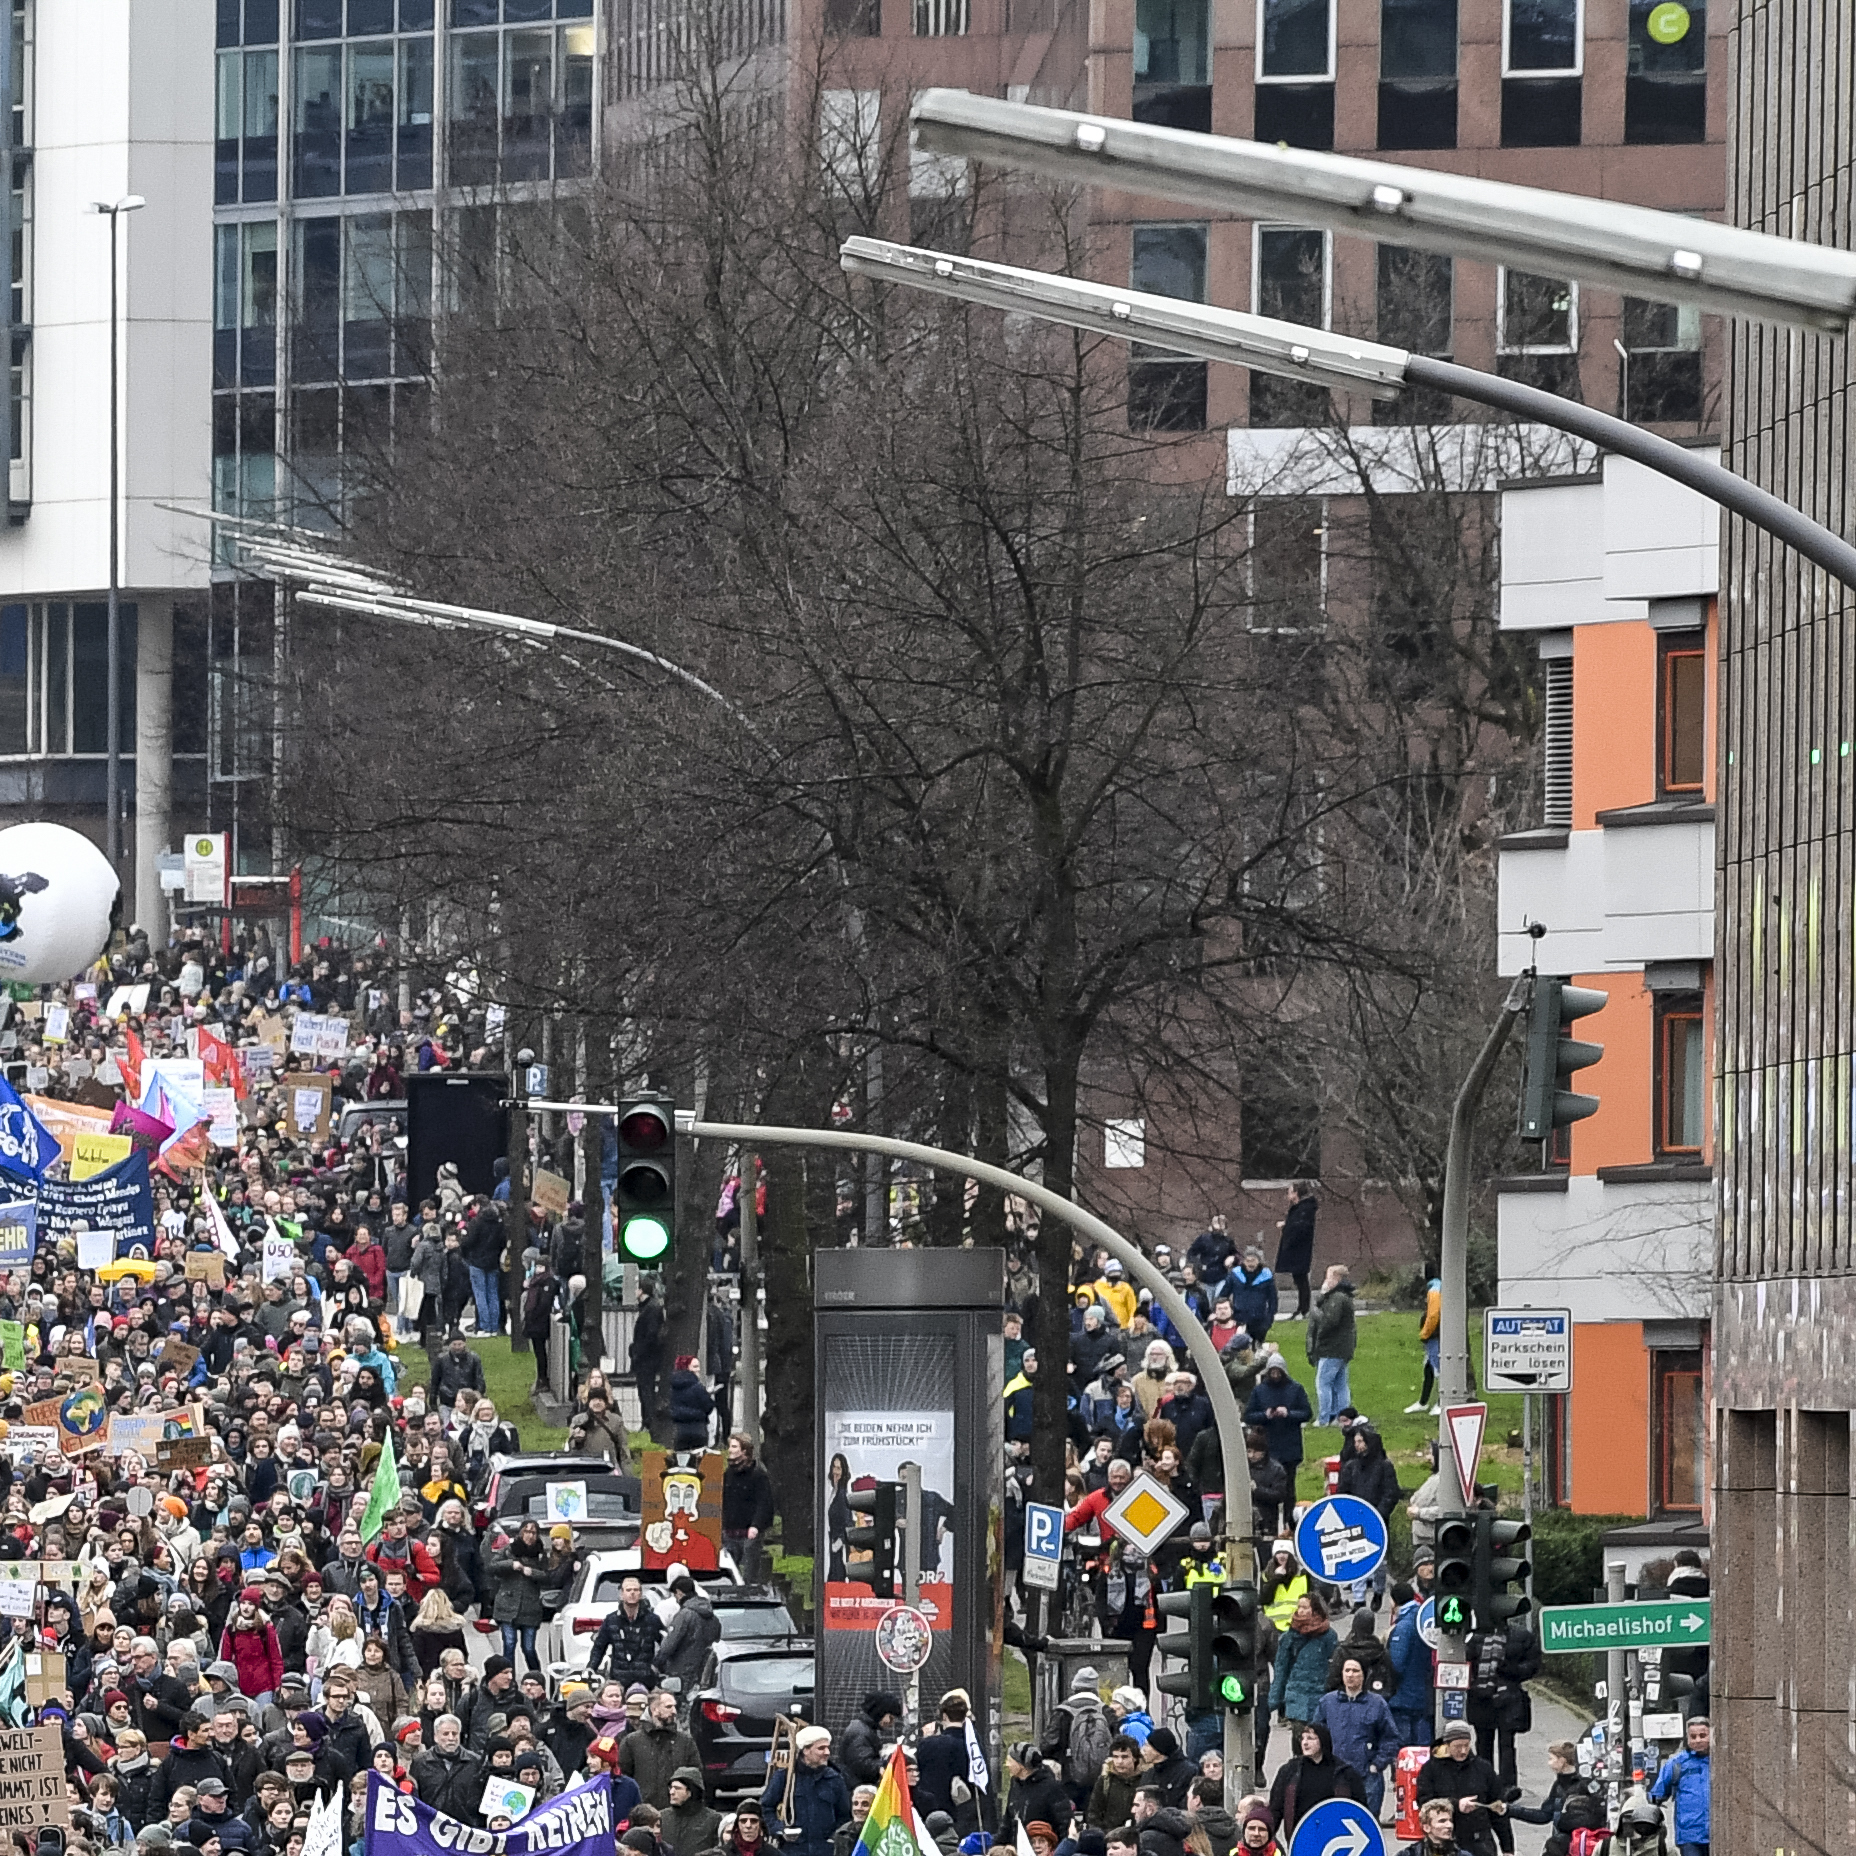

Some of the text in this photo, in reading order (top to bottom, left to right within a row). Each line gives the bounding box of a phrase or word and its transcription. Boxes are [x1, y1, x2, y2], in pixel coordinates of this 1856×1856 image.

[1491, 1341, 1565, 1355] Parkschein
[1490, 1355, 1565, 1369] hier lösen
[854, 1423, 933, 1433] BEIDEN NEHM ICH
[841, 1434, 860, 1447] ZUM
[1032, 1509, 1048, 1540] P
[1550, 1613, 1674, 1640] Michaelishof
[9, 1754, 43, 1772] NICHT
[38, 1776, 60, 1798] IST
[373, 1783, 417, 1835] ES
[428, 1811, 508, 1856] GIBT
[525, 1787, 610, 1851] KEINEN
